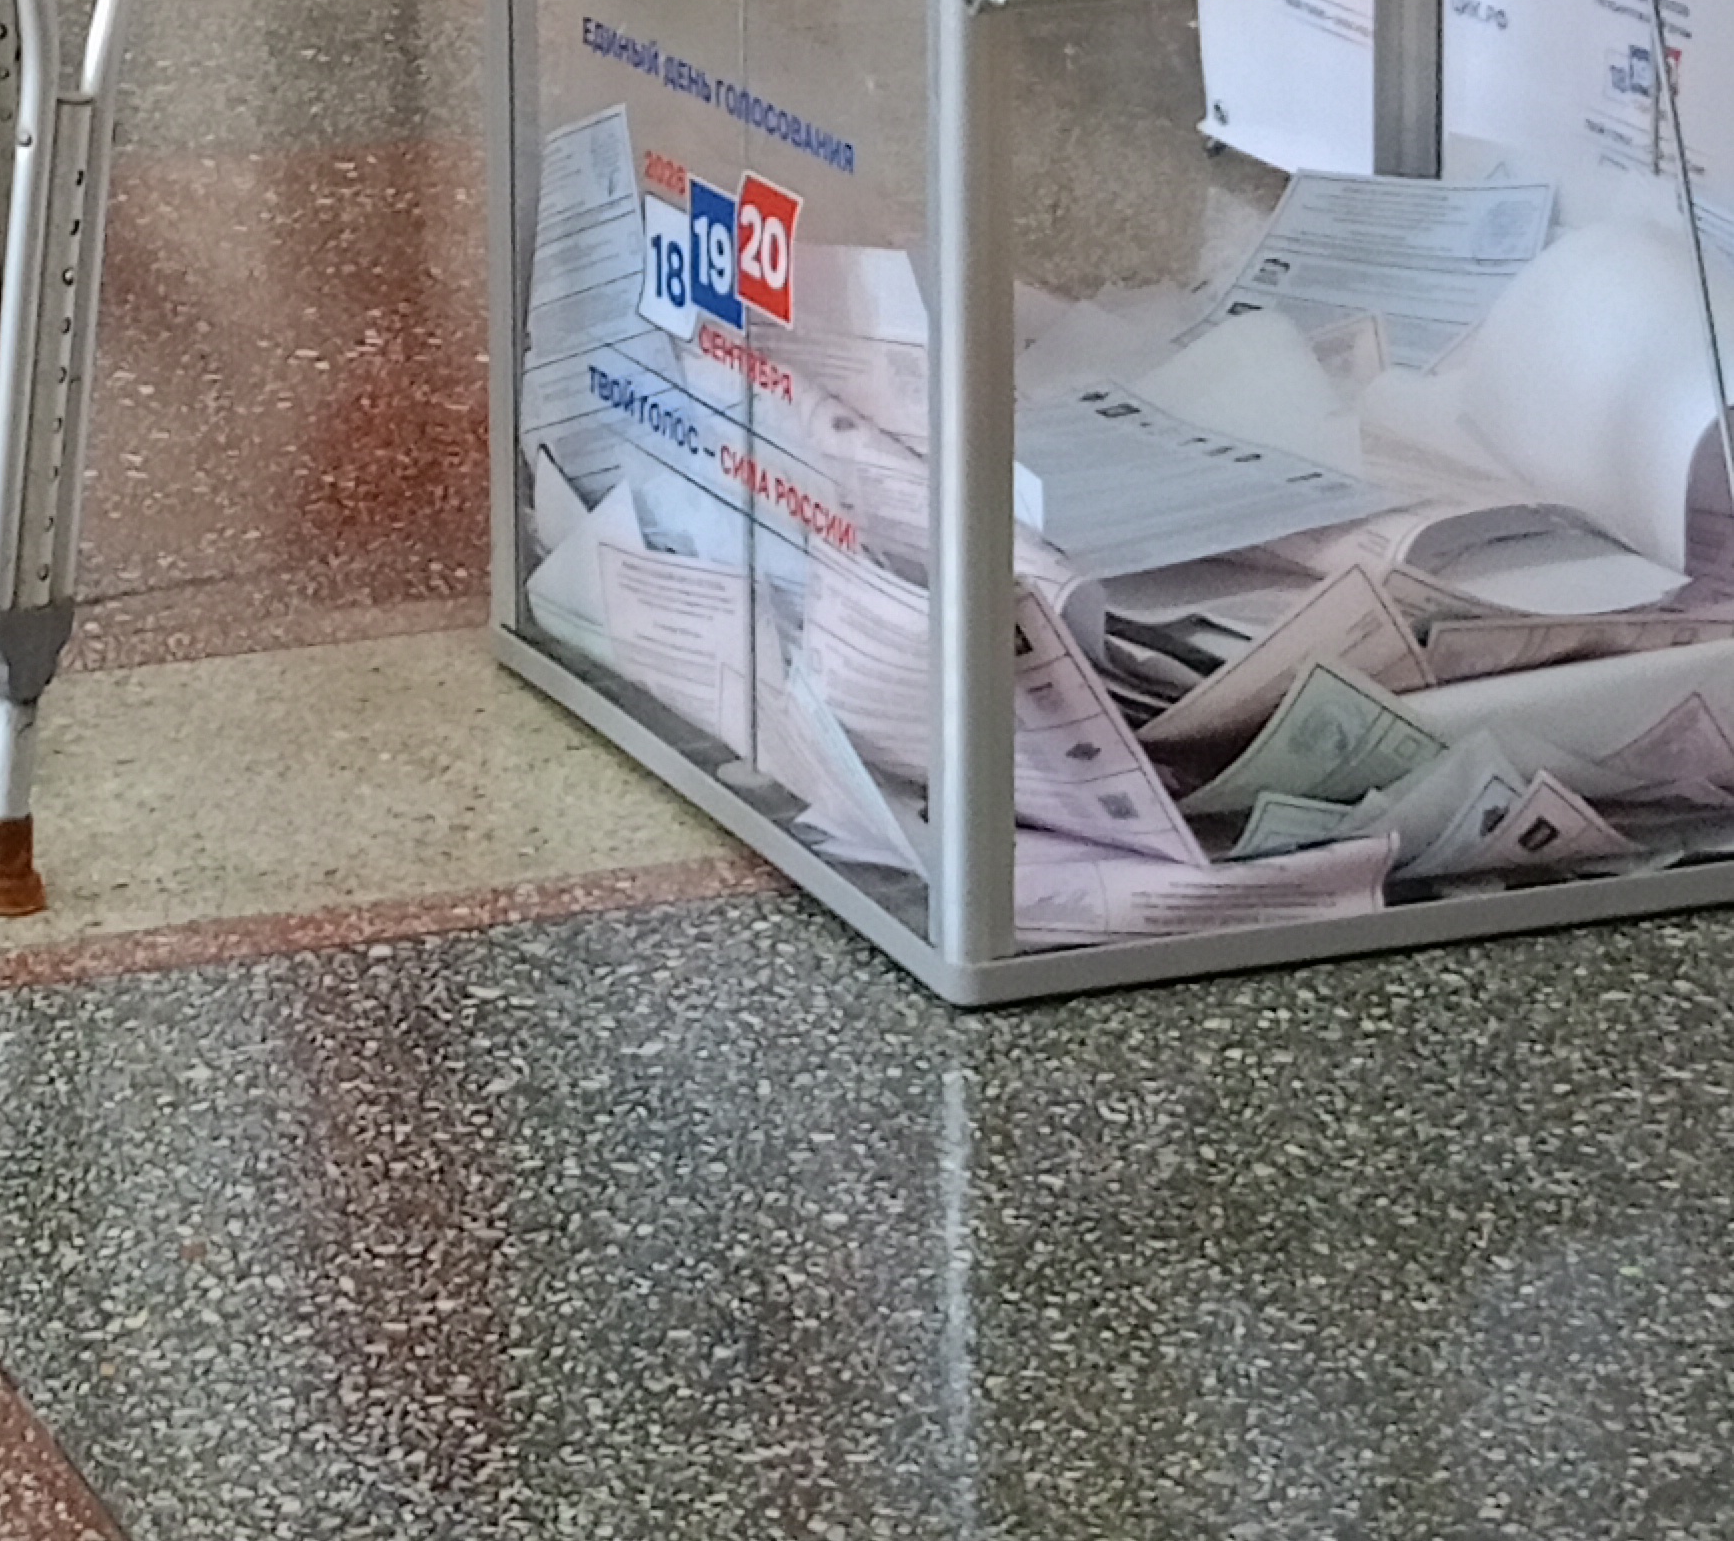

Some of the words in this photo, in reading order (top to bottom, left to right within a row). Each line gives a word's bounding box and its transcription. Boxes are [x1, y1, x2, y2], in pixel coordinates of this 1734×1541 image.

[583, 16, 659, 77] ЕДИНЫЙ
[663, 56, 712, 104] ДЕНЬ
[716, 79, 856, 175] ГОЛОСОВАНИЯ
[651, 233, 687, 309] 18
[692, 213, 734, 296] 19
[738, 202, 790, 291] 20
[698, 323, 793, 405] СЕНТЯБРЯ
[588, 364, 635, 416] ТВОЙ
[638, 395, 699, 455] ГОЛОС
[720, 445, 769, 500] СИЛА
[774, 477, 858, 554] РОССИИ!
